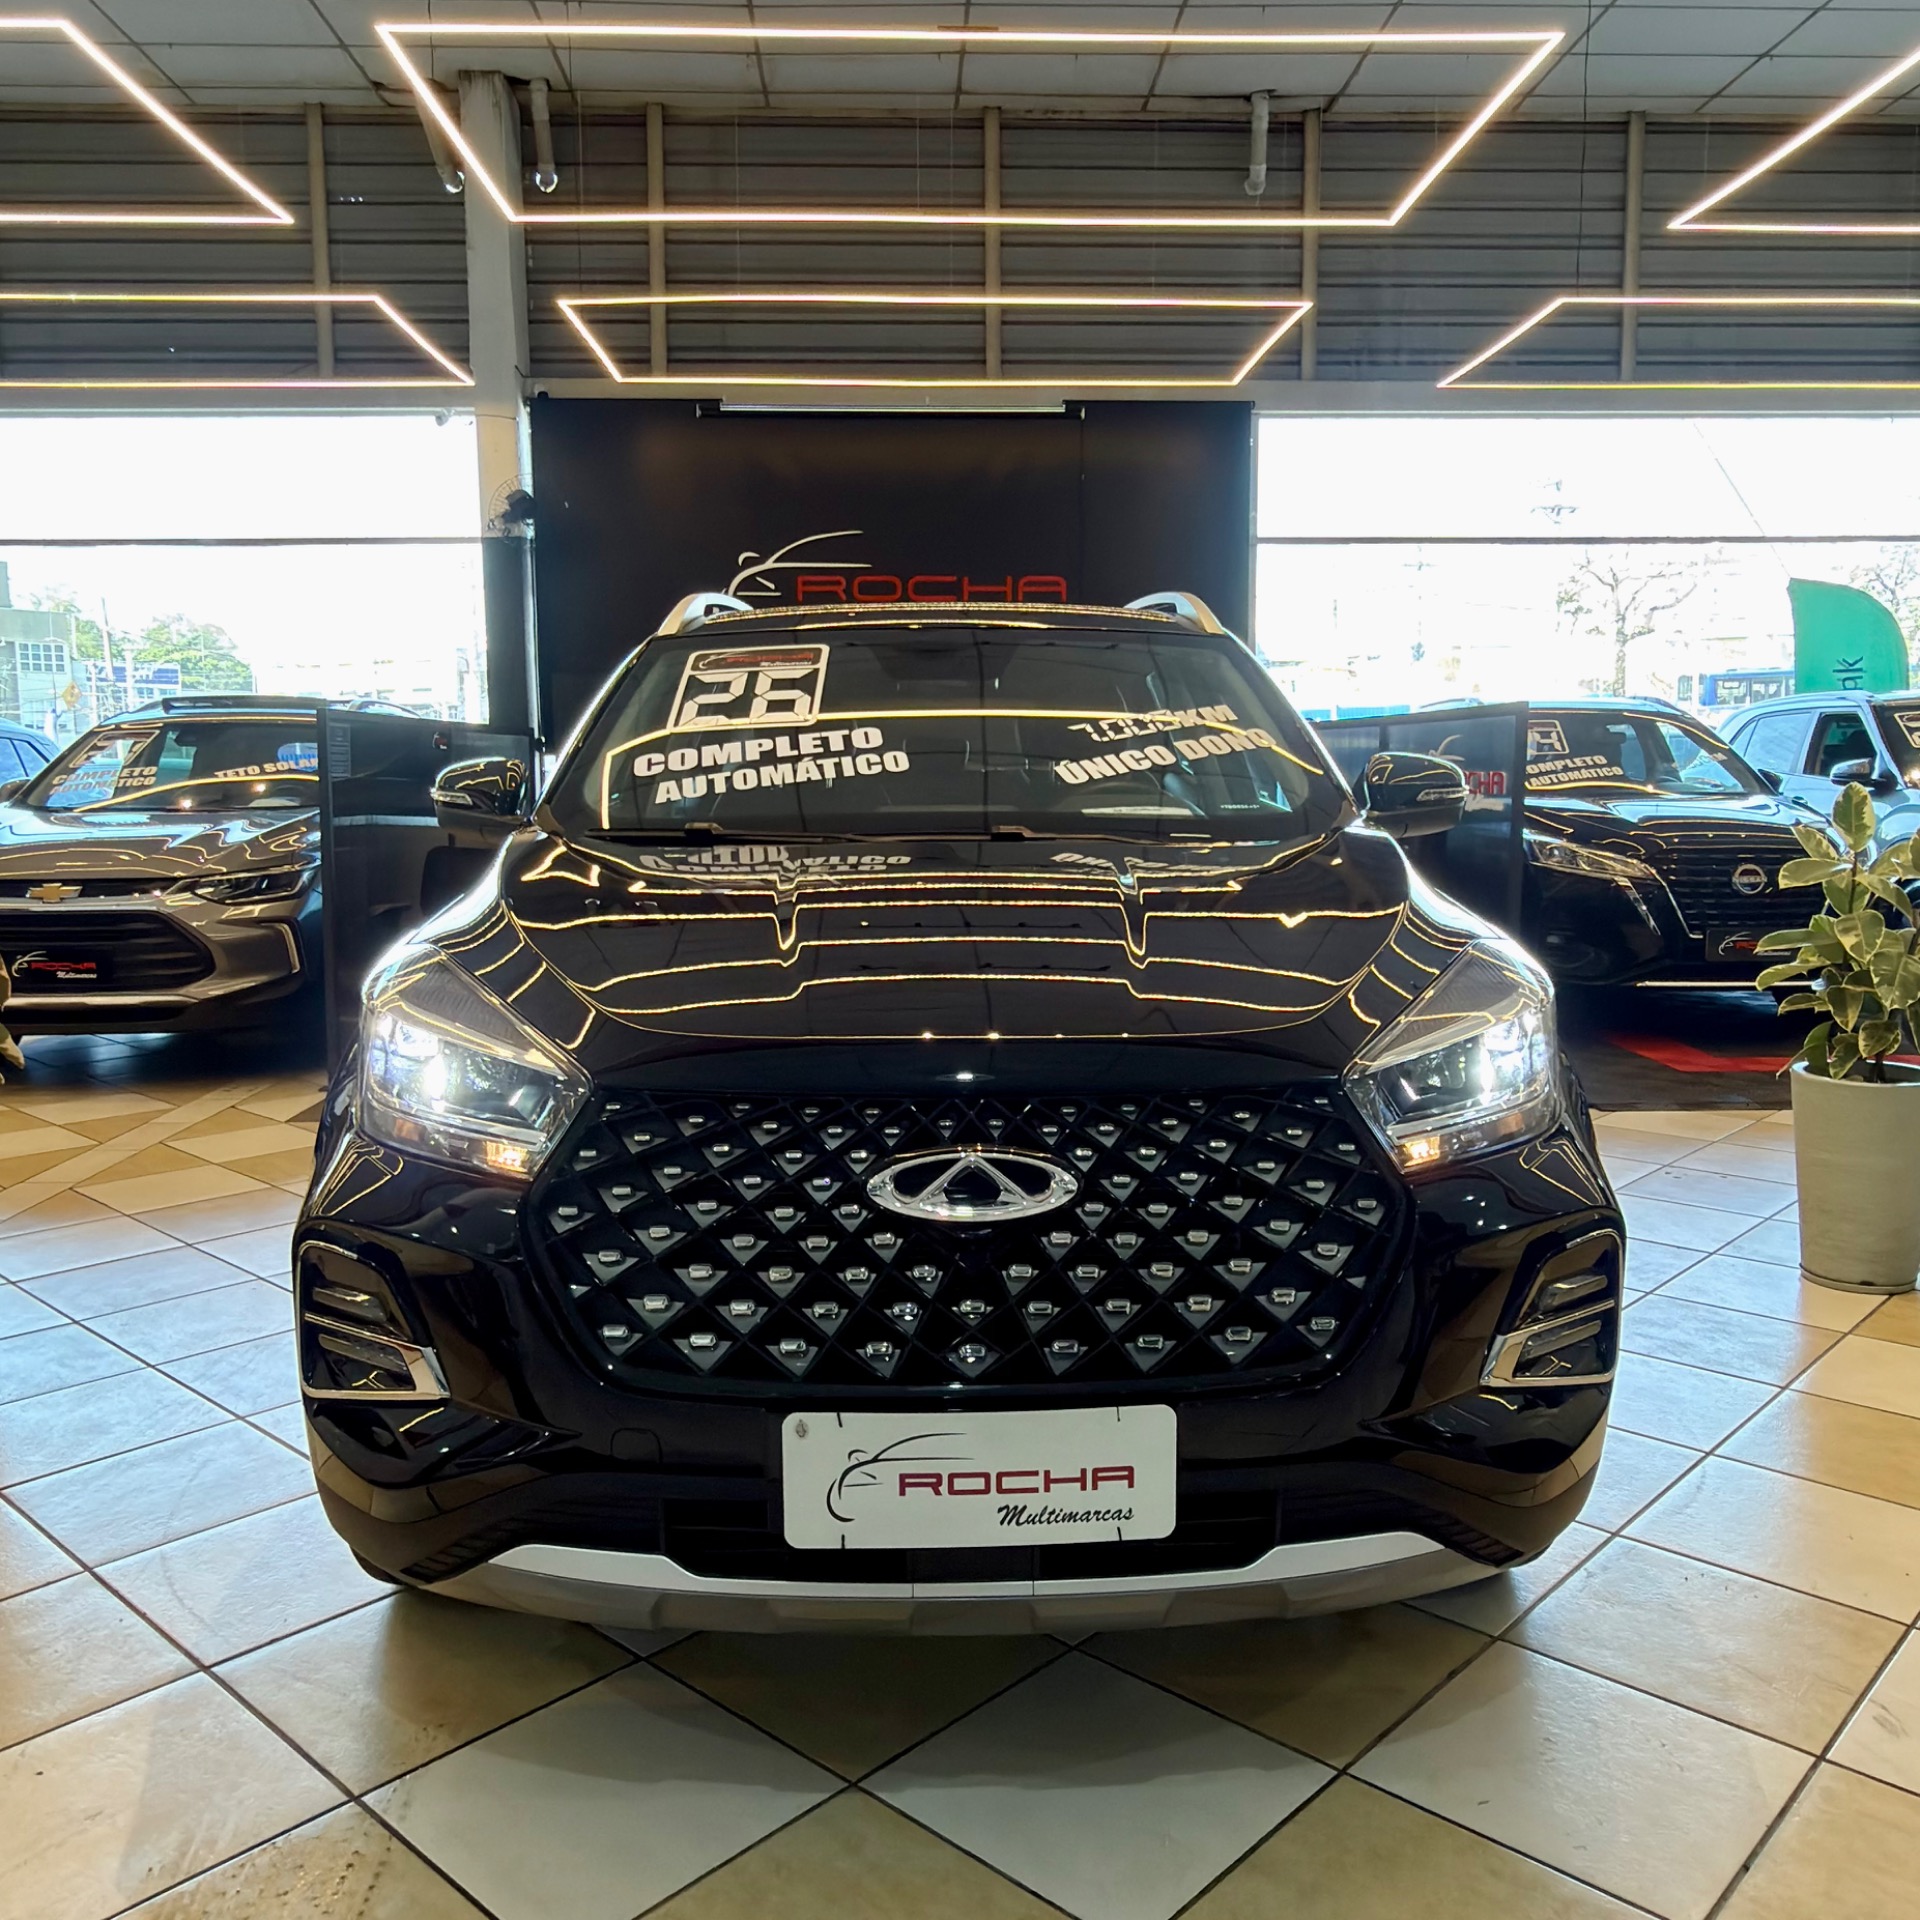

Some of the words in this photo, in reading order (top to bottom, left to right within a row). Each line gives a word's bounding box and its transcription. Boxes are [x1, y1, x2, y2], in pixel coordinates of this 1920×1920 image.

[797, 574, 1067, 603] ROCHA
[680, 668, 811, 726] 26
[634, 727, 883, 776] COMPLETO
[1055, 745, 1177, 784] ÚNICO
[1174, 728, 1277, 761] DONO
[1526, 755, 1608, 774] OMPLETO
[214, 765, 260, 778] TETO
[655, 750, 910, 803] AUTOMÁTICO
[1529, 766, 1624, 786] AUTOMÁTICO
[898, 1466, 1134, 1496] ROCHA
[997, 1504, 1135, 1527] Multimarcas
